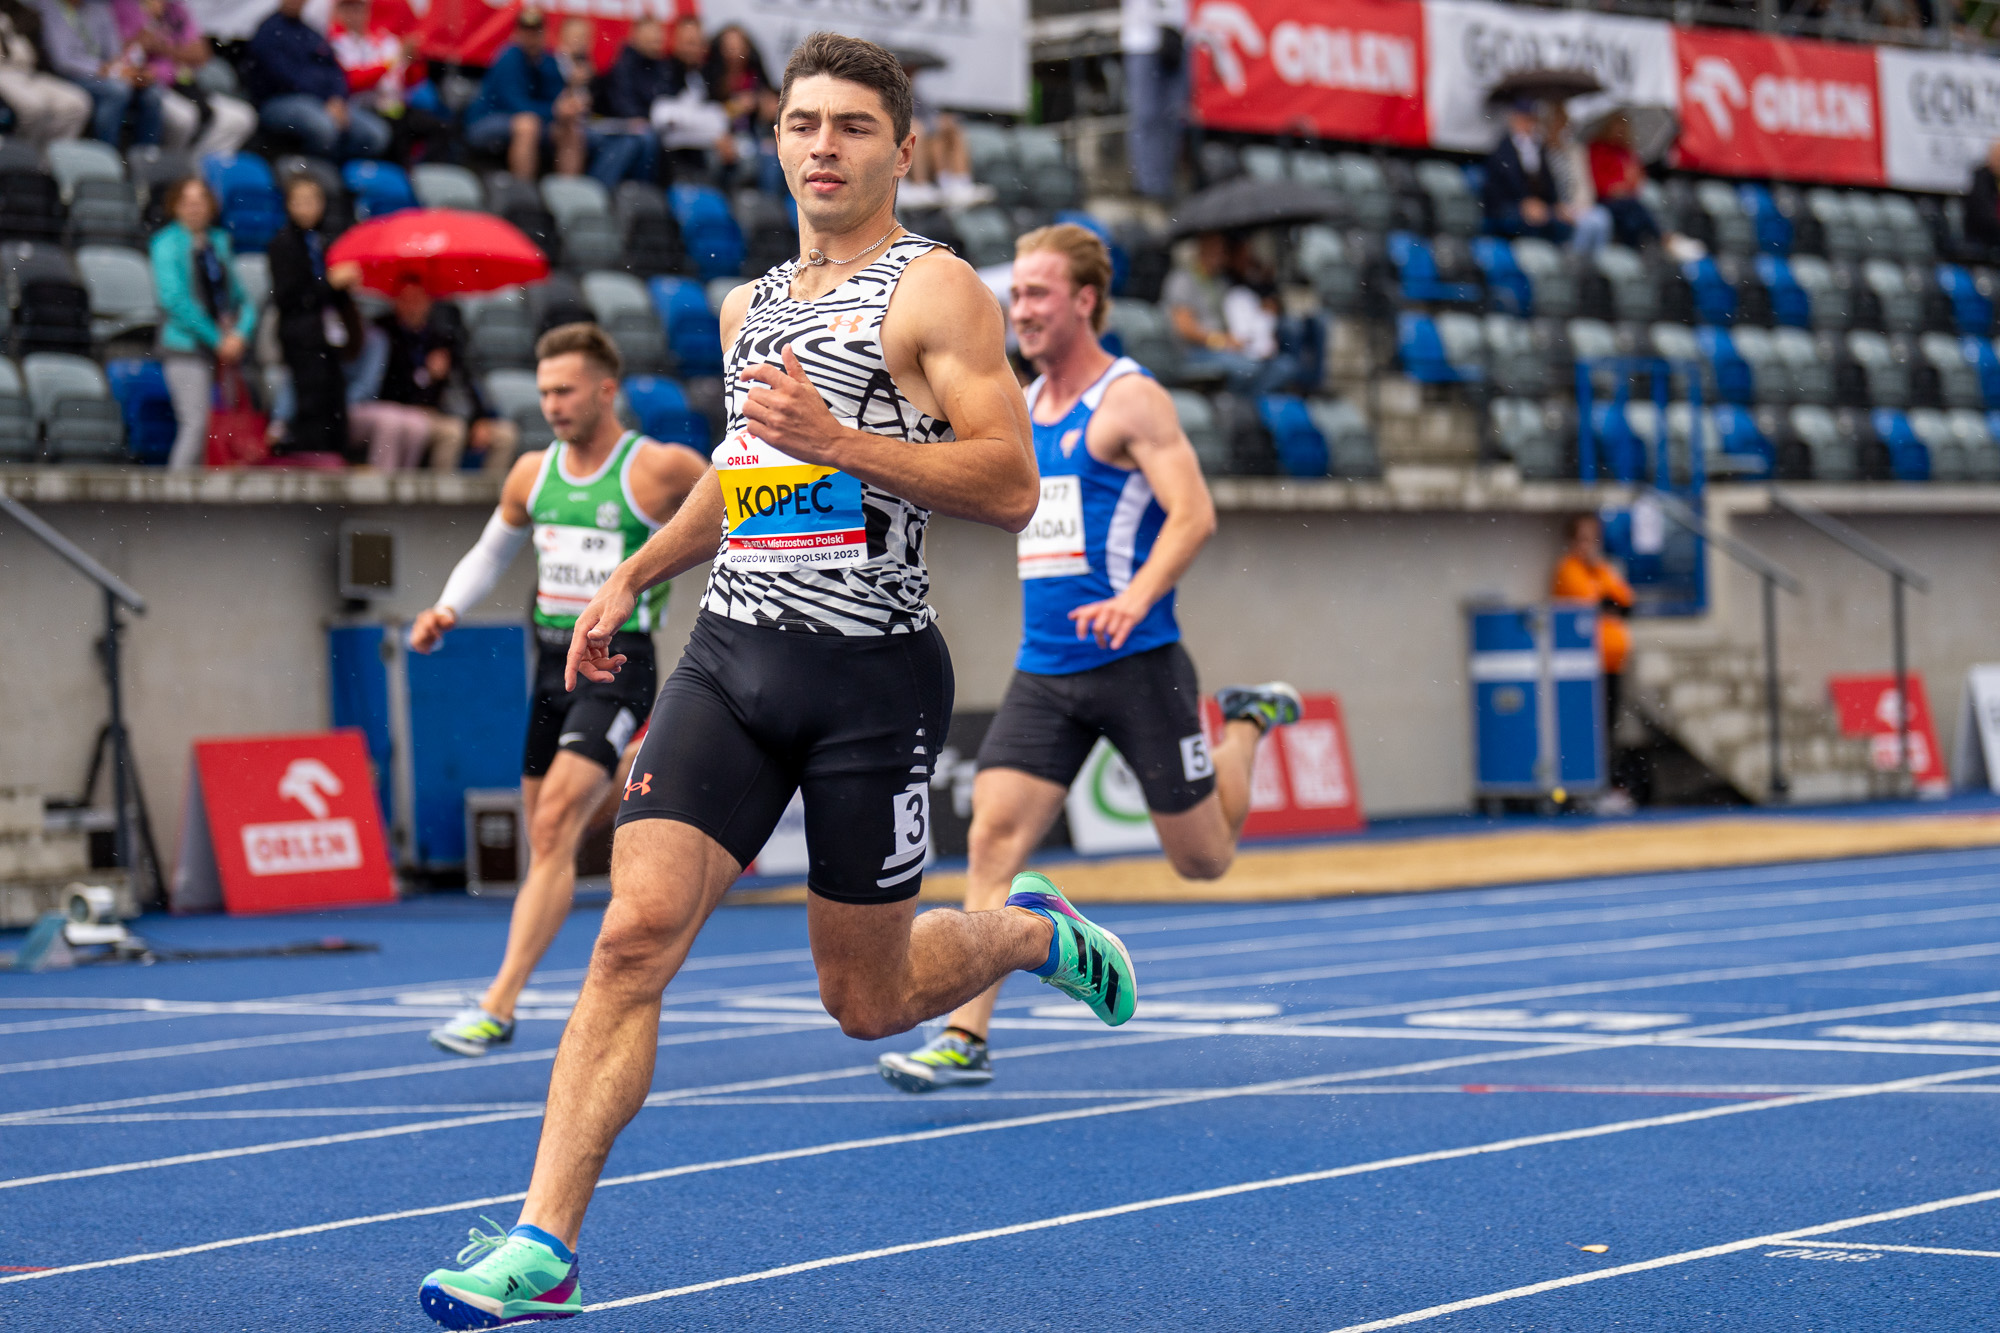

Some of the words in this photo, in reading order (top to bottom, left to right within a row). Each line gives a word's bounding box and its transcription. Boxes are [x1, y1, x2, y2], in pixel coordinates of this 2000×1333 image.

[1269, 20, 1416, 97] ORLEN
[1751, 73, 1874, 138] ORLEN
[727, 454, 759, 466] ORLEN
[735, 474, 834, 518] KOPEĆ
[730, 553, 767, 563] GORZÓW
[768, 551, 832, 563] WIELKOPOLSKI
[833, 549, 860, 560] 2023
[767, 537, 814, 548] Mistrzostwa
[815, 534, 844, 546] Polski
[1193, 741, 1208, 772] 5
[906, 793, 925, 845] 3
